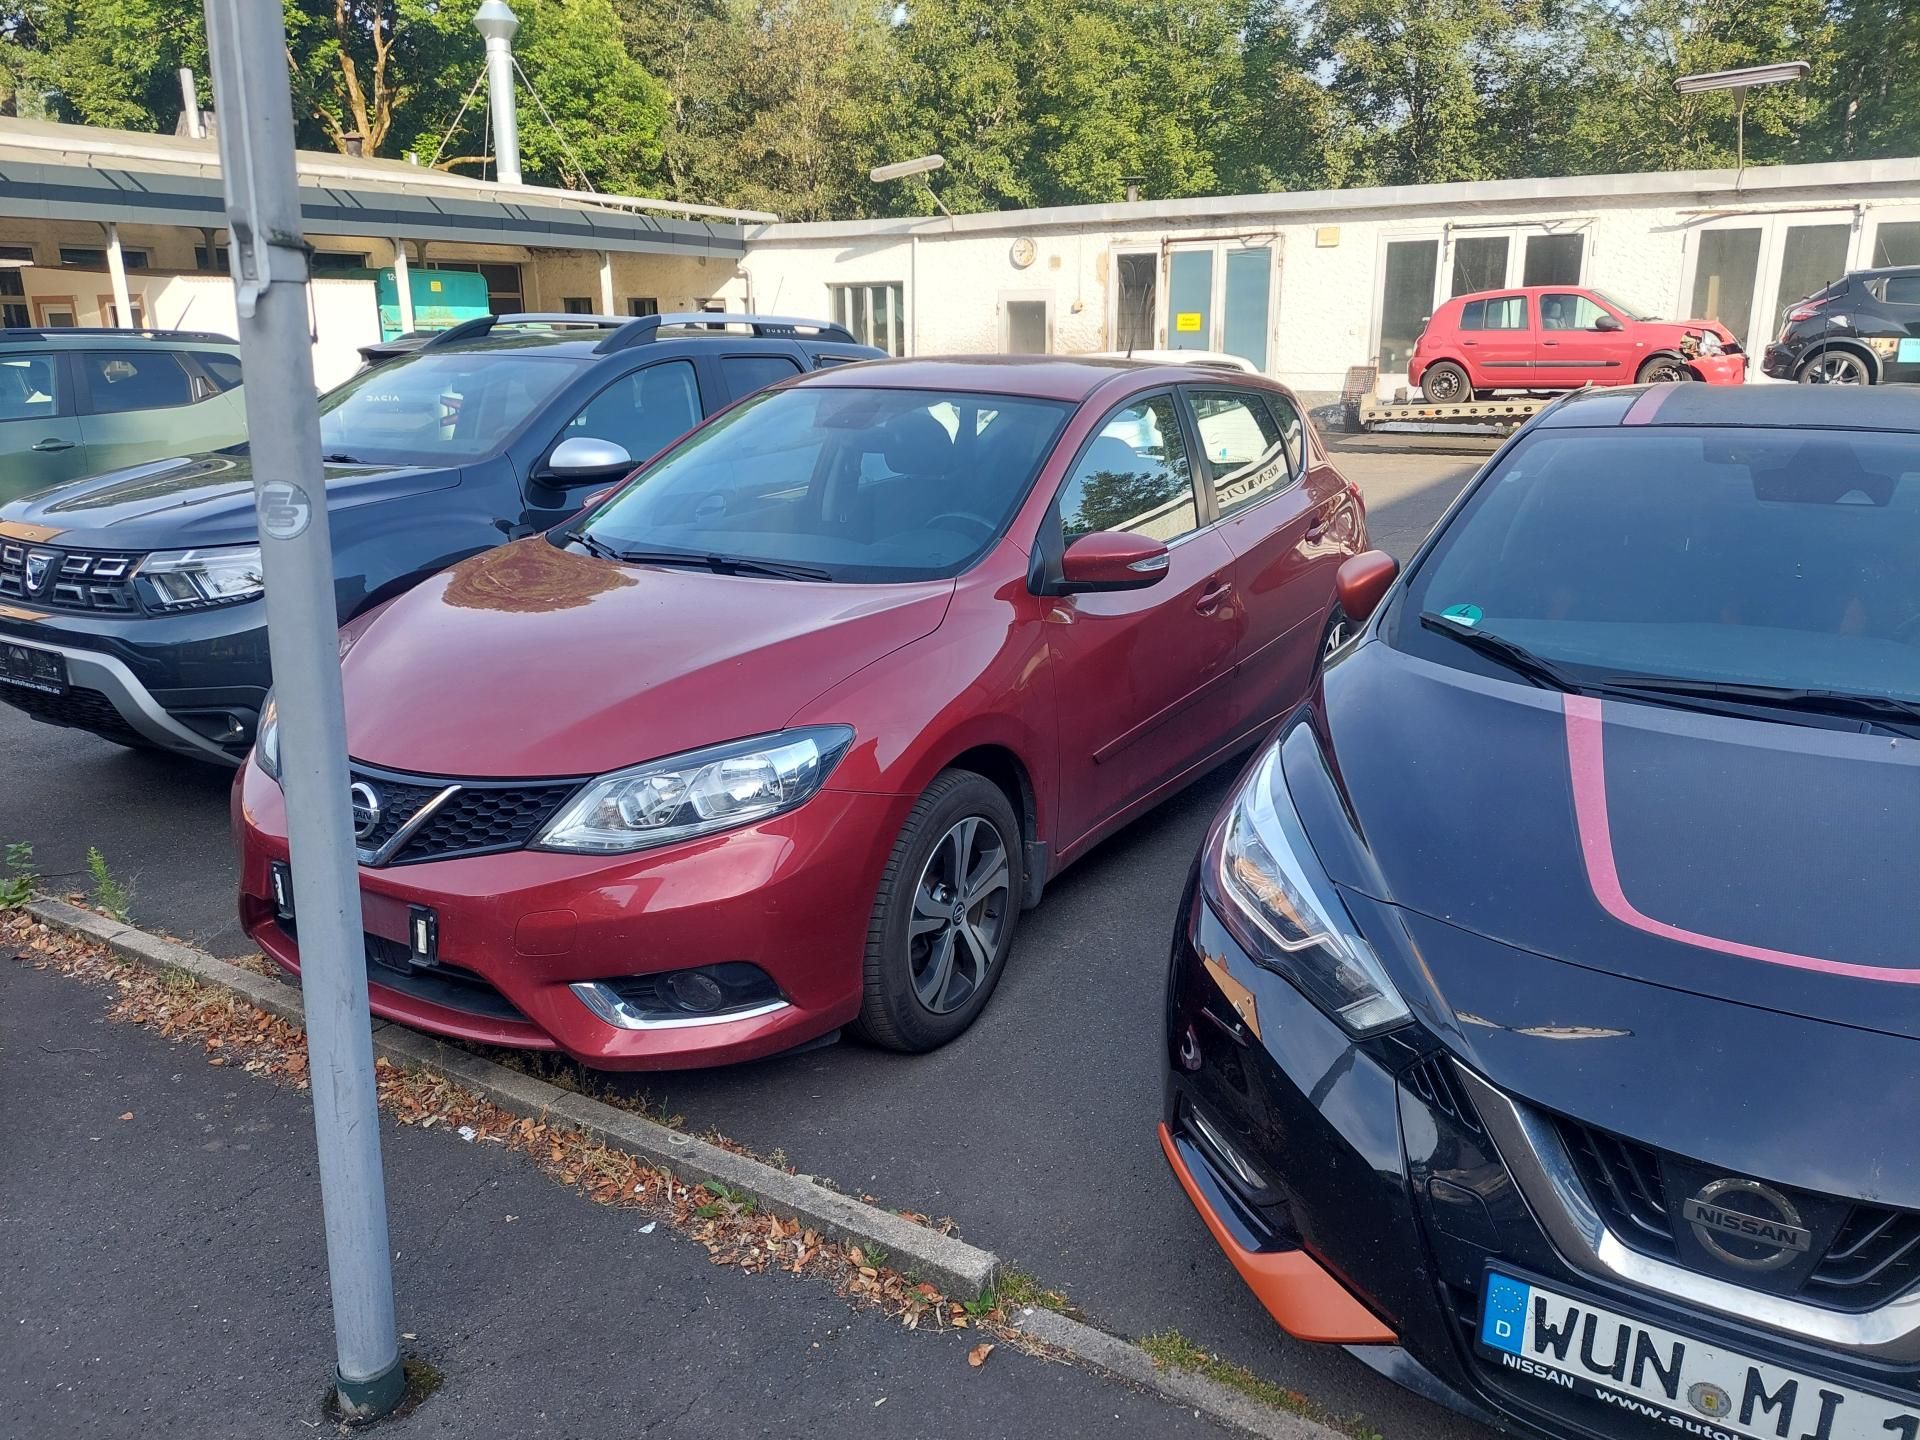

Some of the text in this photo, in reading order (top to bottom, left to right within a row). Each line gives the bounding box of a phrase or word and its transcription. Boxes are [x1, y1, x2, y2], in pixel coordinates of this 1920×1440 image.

[1456, 604, 1472, 618] 4
[1696, 1206, 1798, 1245] NISSAN
[1496, 1320, 1511, 1337] D
[1502, 1353, 1575, 1389] NISSAN
[1534, 1296, 1845, 1440] WUN MI
[1595, 1388, 1744, 1440] www.auto
